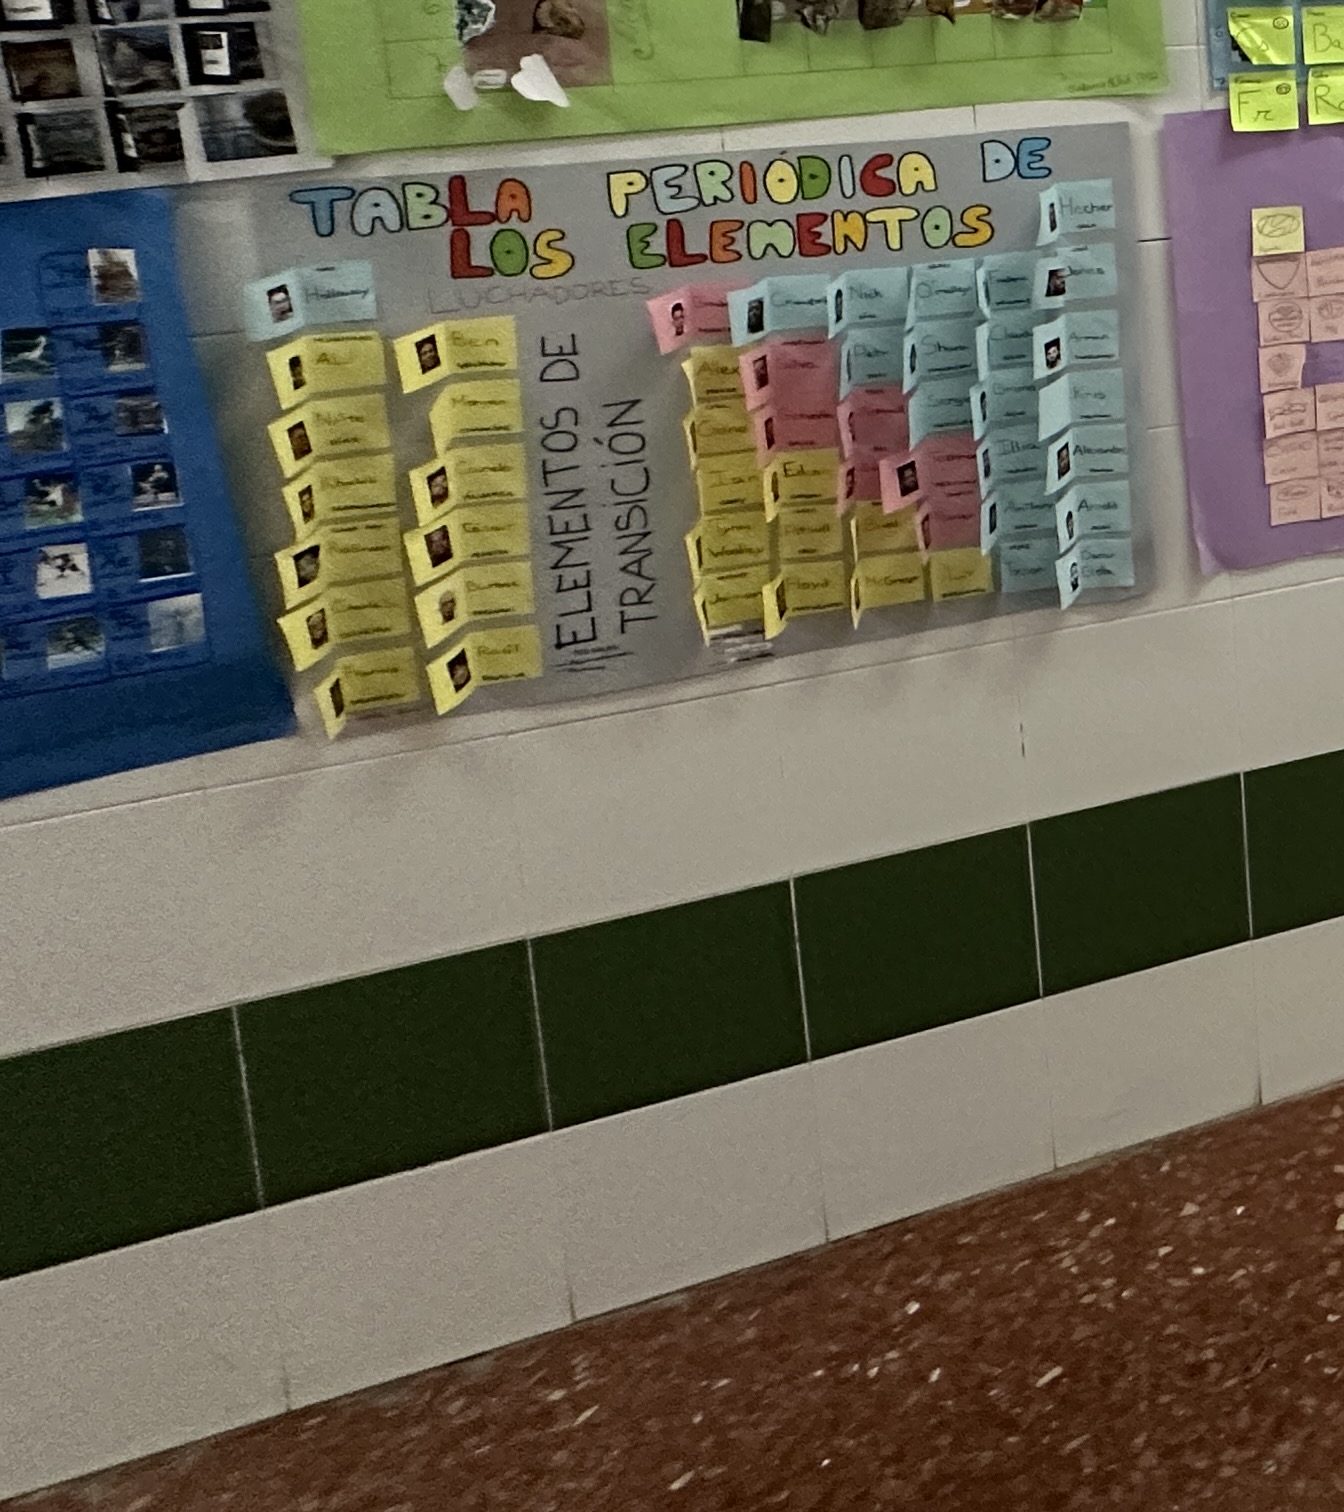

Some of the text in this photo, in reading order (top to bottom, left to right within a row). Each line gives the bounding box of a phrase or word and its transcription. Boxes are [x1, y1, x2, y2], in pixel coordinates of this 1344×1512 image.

[1237, 89, 1275, 125] Fr
[289, 136, 1053, 238] TABLA PERIÓDICA DE
[449, 204, 994, 281] LOS ELEMENTOS
[540, 332, 598, 651] ELEMENTOS DE
[600, 397, 659, 635] TRANSICIÓN
